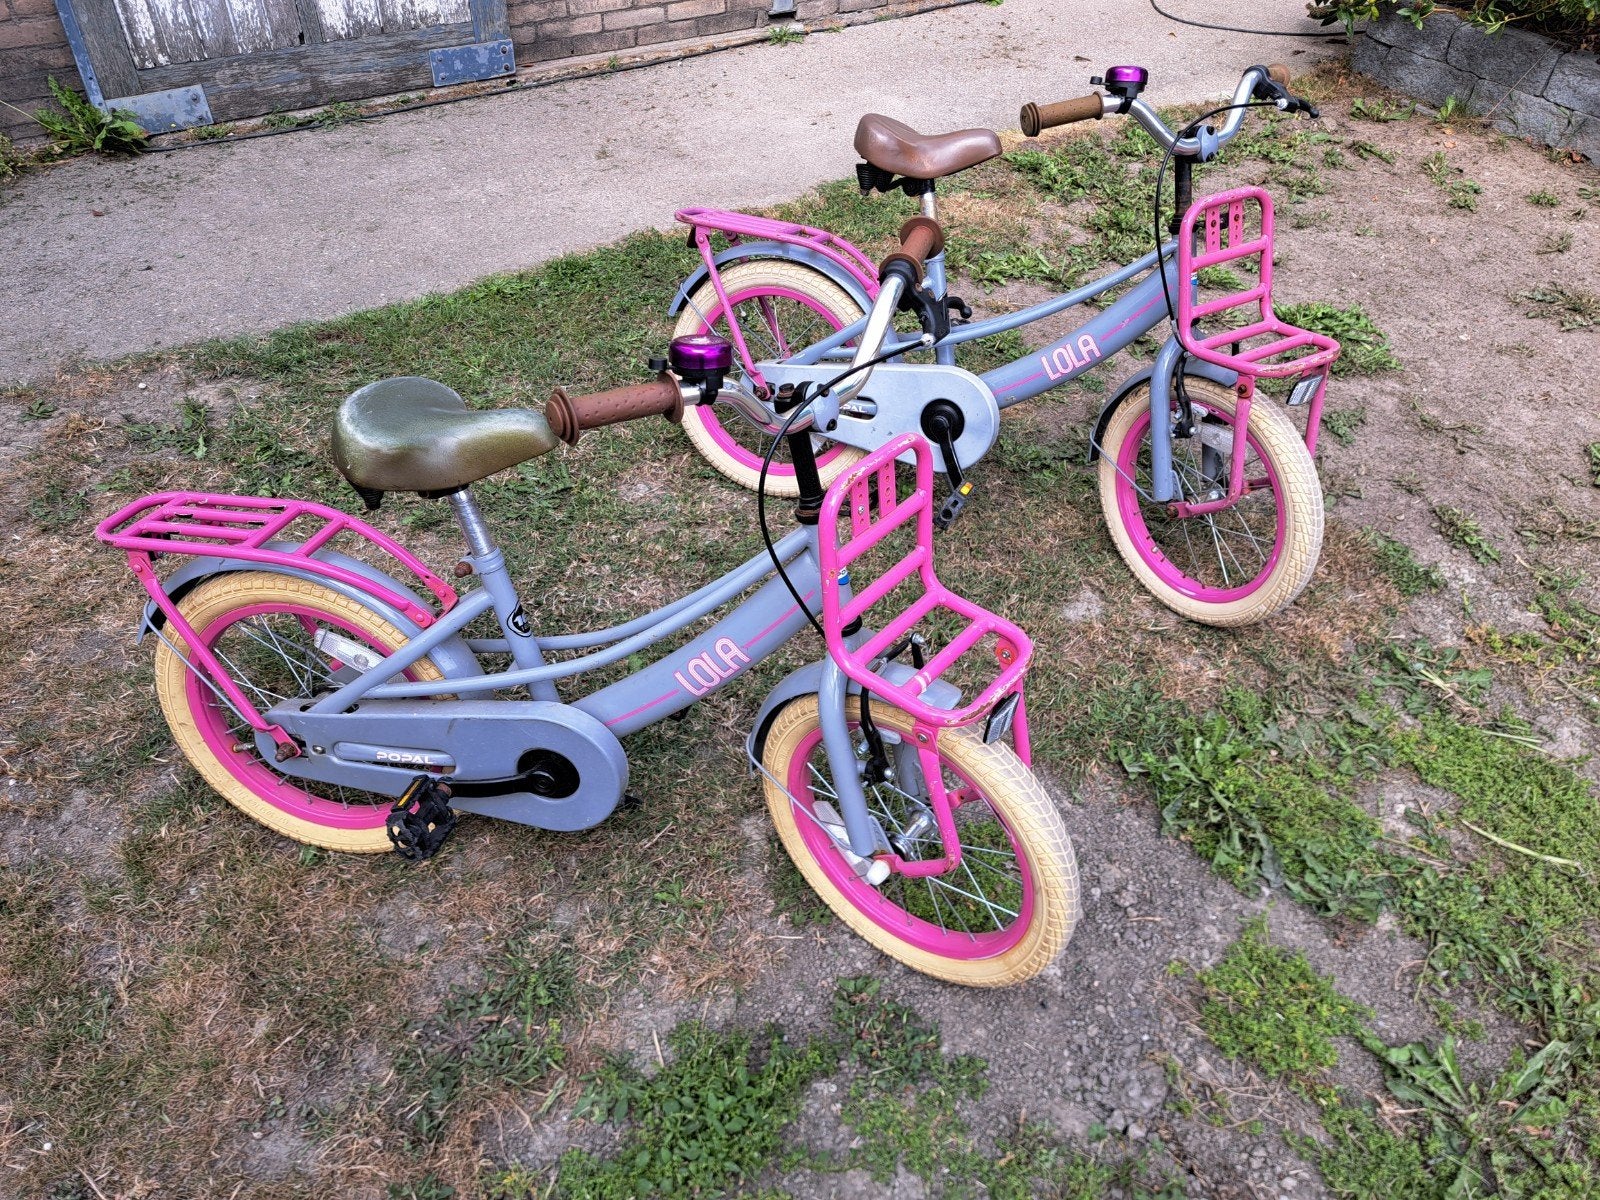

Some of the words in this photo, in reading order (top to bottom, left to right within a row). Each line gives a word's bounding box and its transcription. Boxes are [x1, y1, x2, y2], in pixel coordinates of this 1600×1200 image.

[1041, 333, 1102, 381] LOLA
[674, 637, 751, 696] LOLA
[376, 751, 434, 764] POPAL
